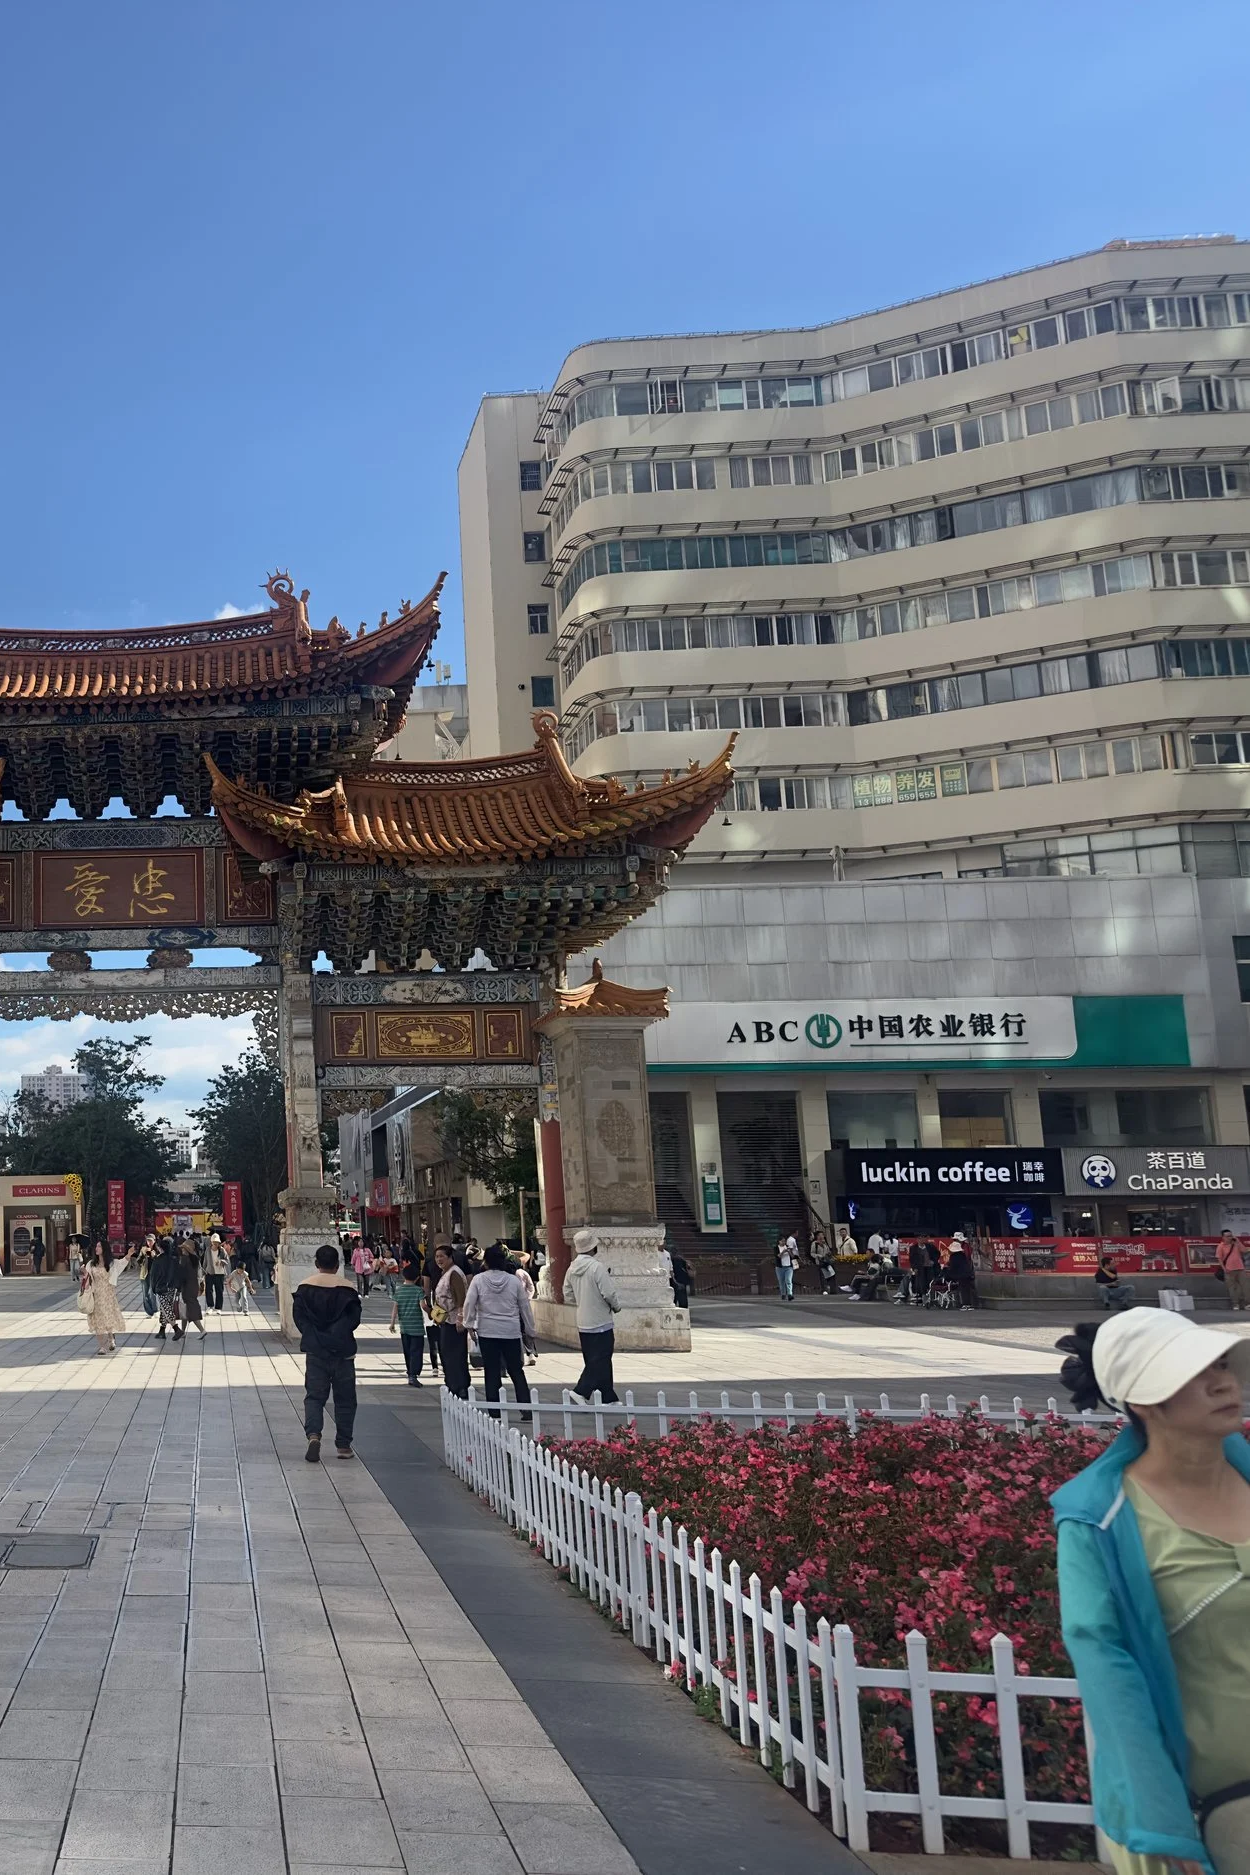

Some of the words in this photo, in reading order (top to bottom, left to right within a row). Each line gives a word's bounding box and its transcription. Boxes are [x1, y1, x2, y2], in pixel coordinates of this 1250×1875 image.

[854, 771, 935, 797] 植物养发
[726, 1021, 799, 1043] ABC
[849, 1012, 1027, 1040] 中国农业银行
[1022, 1162, 1044, 1172] 瑞幸
[1147, 1152, 1207, 1170] 茶百道
[861, 1162, 930, 1182] luckin
[938, 1161, 1011, 1182] coffee
[1023, 1173, 1045, 1183] 咖啡
[1127, 1173, 1234, 1191] ChaPanda
